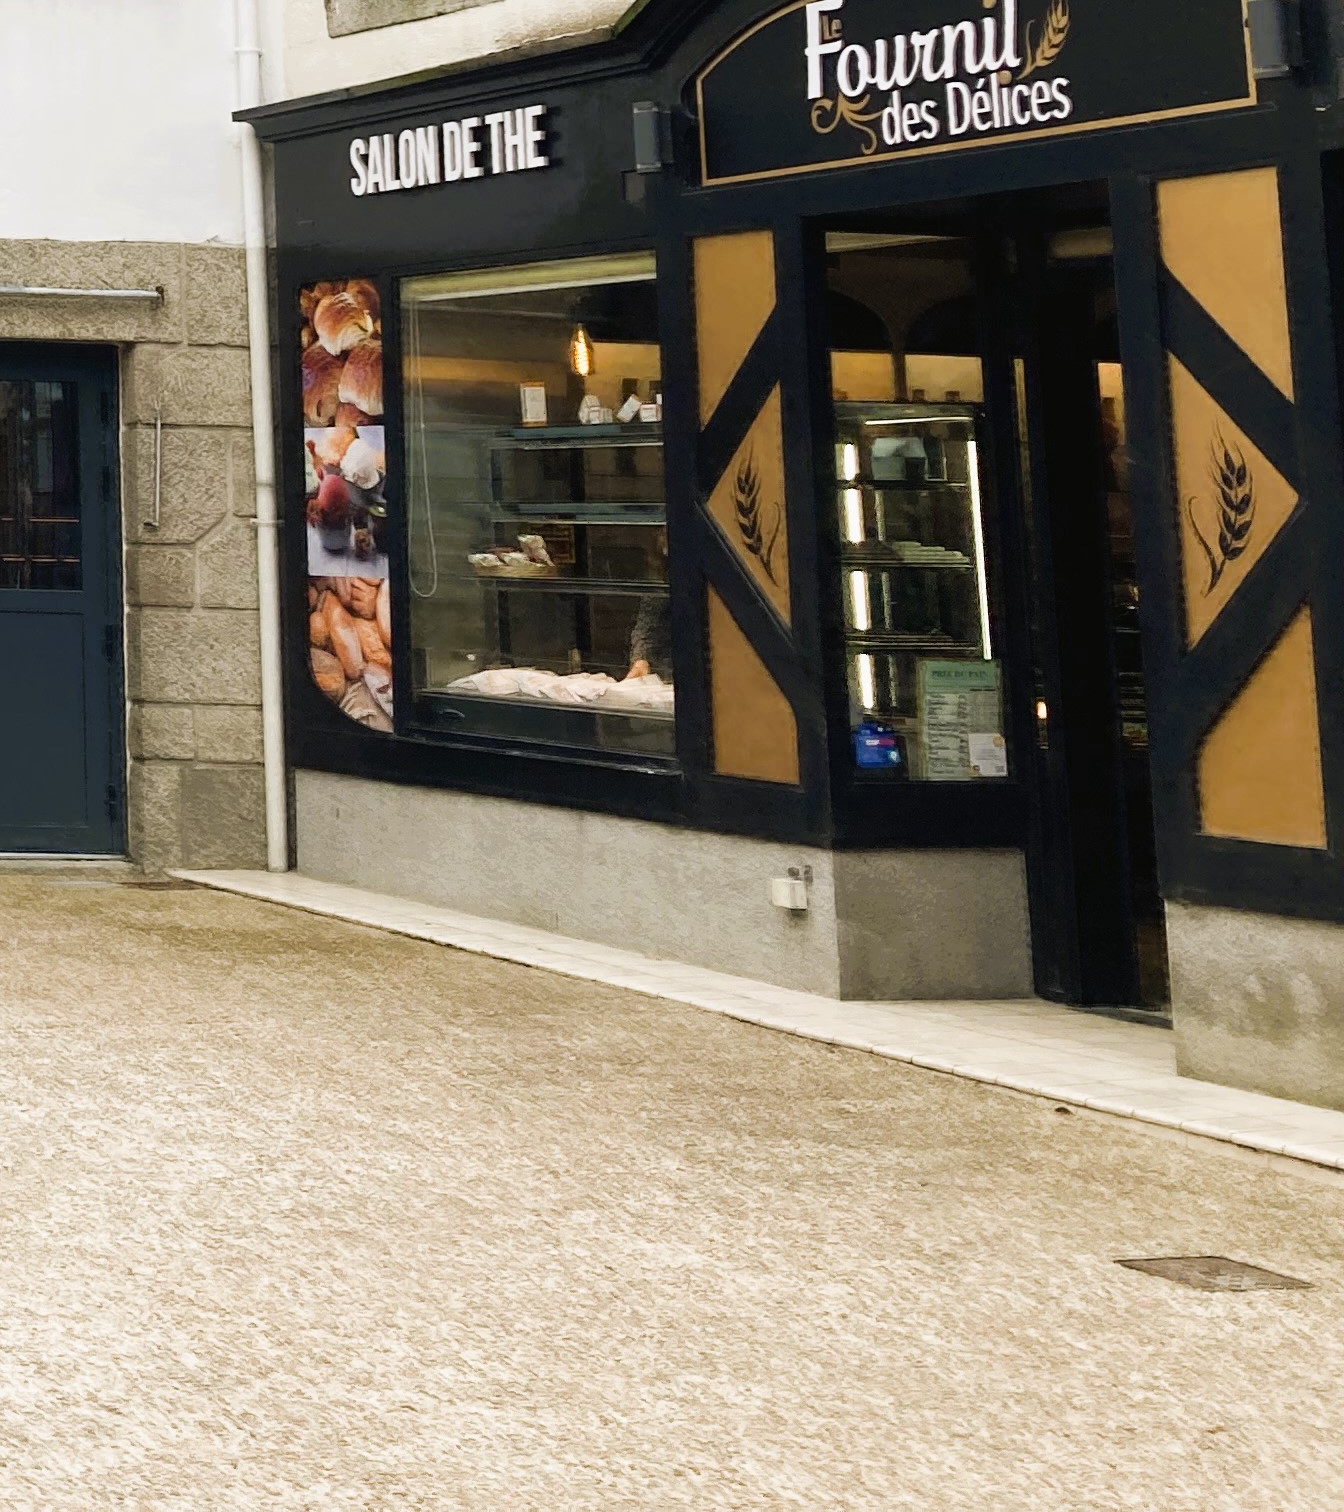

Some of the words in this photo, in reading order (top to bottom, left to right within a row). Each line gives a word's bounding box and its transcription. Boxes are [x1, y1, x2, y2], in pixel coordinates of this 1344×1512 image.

[821, 14, 843, 41] Le
[881, 91, 939, 146] des
[947, 70, 1072, 135] Délices
[349, 125, 440, 196] SALON
[442, 116, 484, 182] DE
[484, 104, 549, 175] THE
